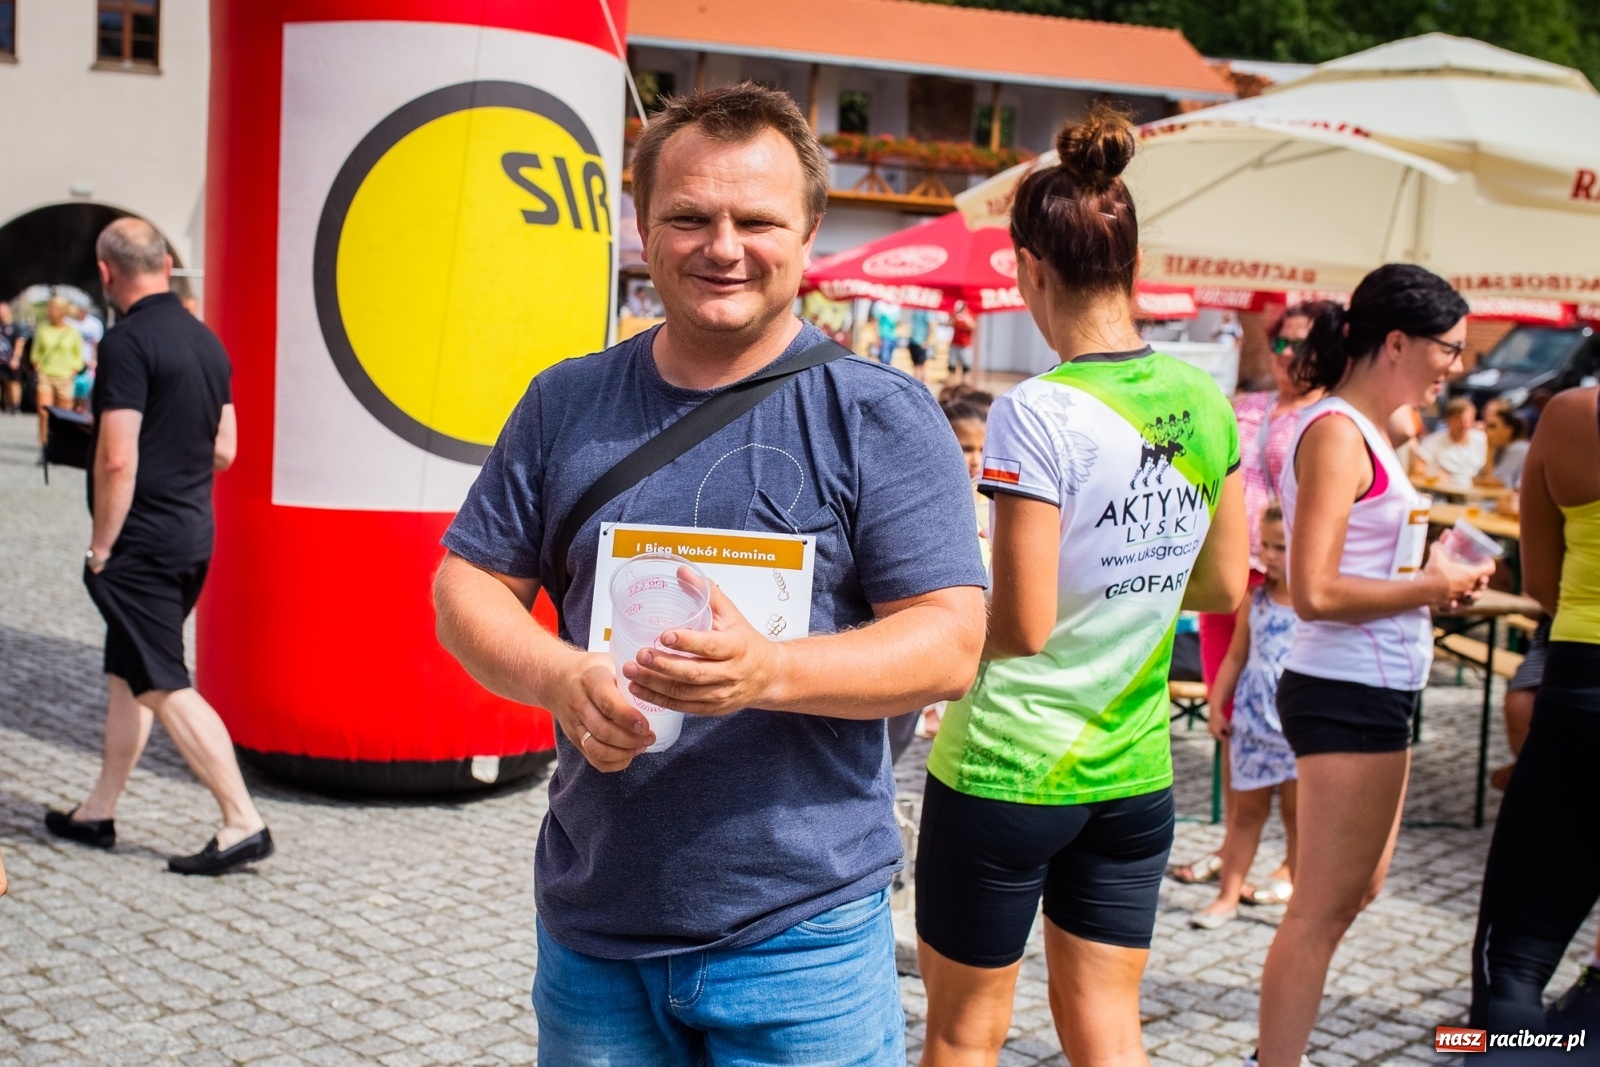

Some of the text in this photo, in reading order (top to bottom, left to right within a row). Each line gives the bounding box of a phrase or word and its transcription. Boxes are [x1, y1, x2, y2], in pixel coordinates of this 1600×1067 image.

[1095, 479, 1220, 528] AKTYWNI
[1126, 513, 1197, 543] LYSKI
[645, 543, 673, 556] Bieg
[677, 545, 718, 557] Wokół
[723, 547, 776, 561] Komina
